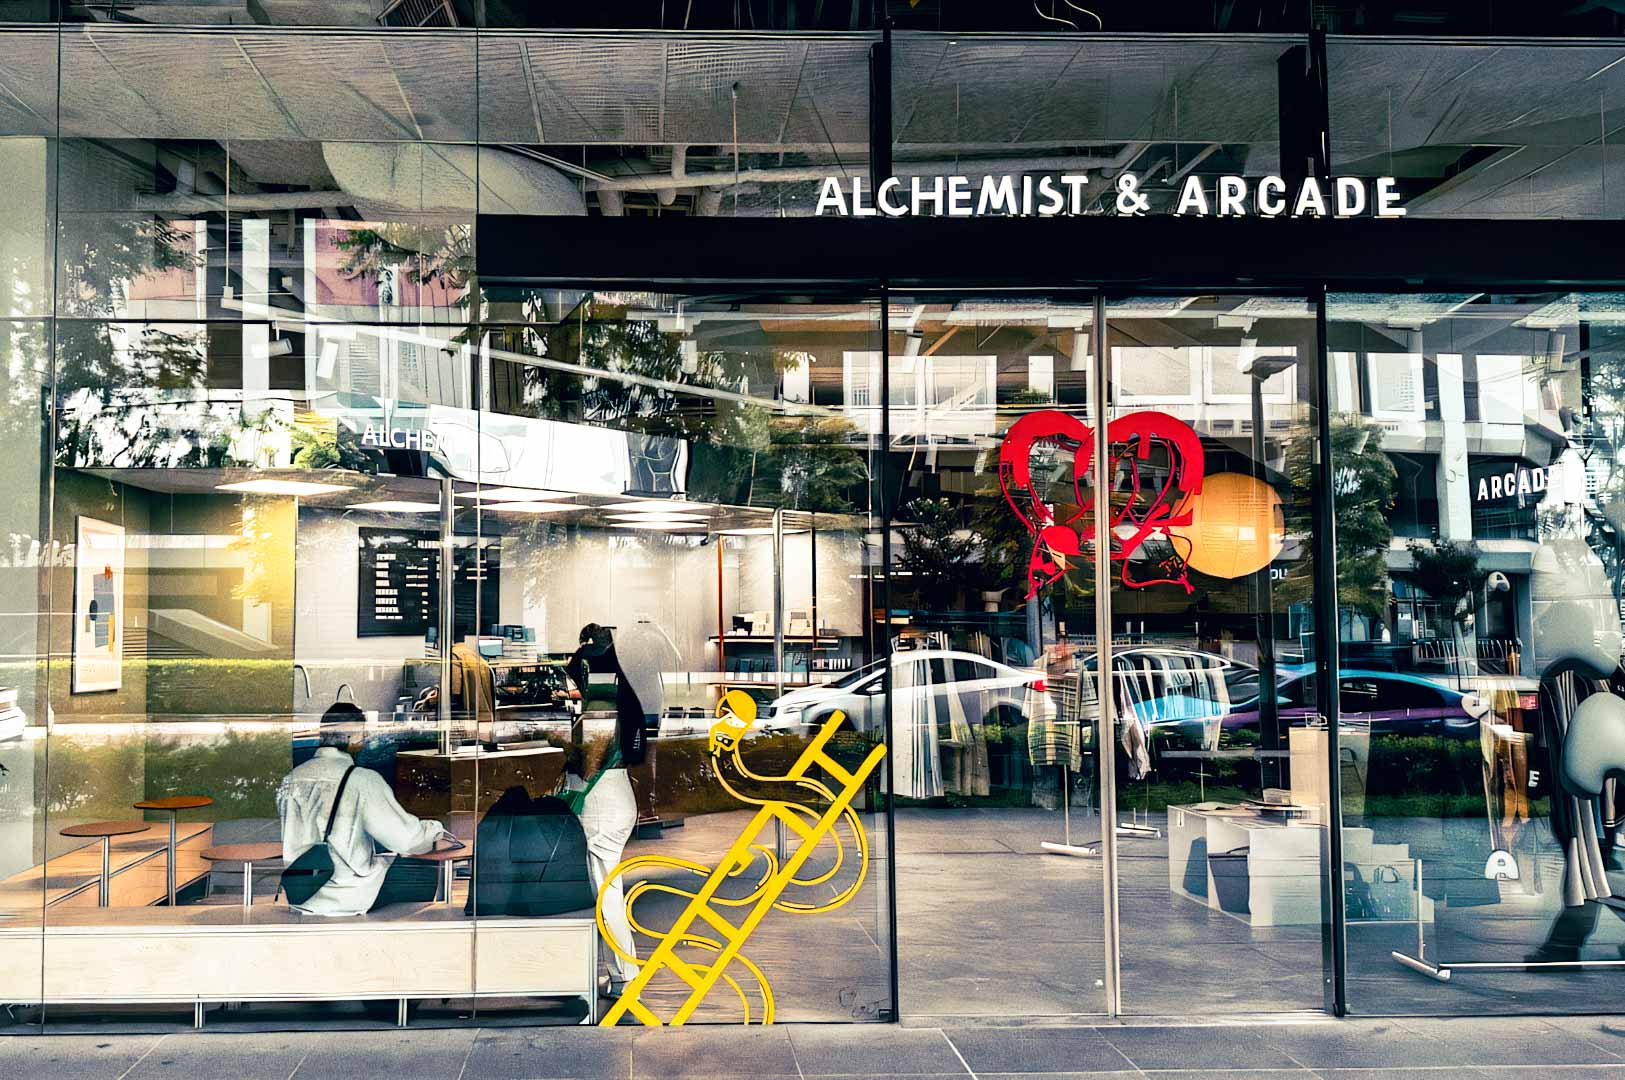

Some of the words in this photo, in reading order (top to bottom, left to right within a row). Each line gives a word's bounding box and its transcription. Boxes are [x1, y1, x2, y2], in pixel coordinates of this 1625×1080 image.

[815, 175, 1089, 216] ALCHEMIST
[1116, 173, 1150, 214] &
[1177, 175, 1407, 217] ARCADE
[1477, 468, 1548, 501] ARCAD
